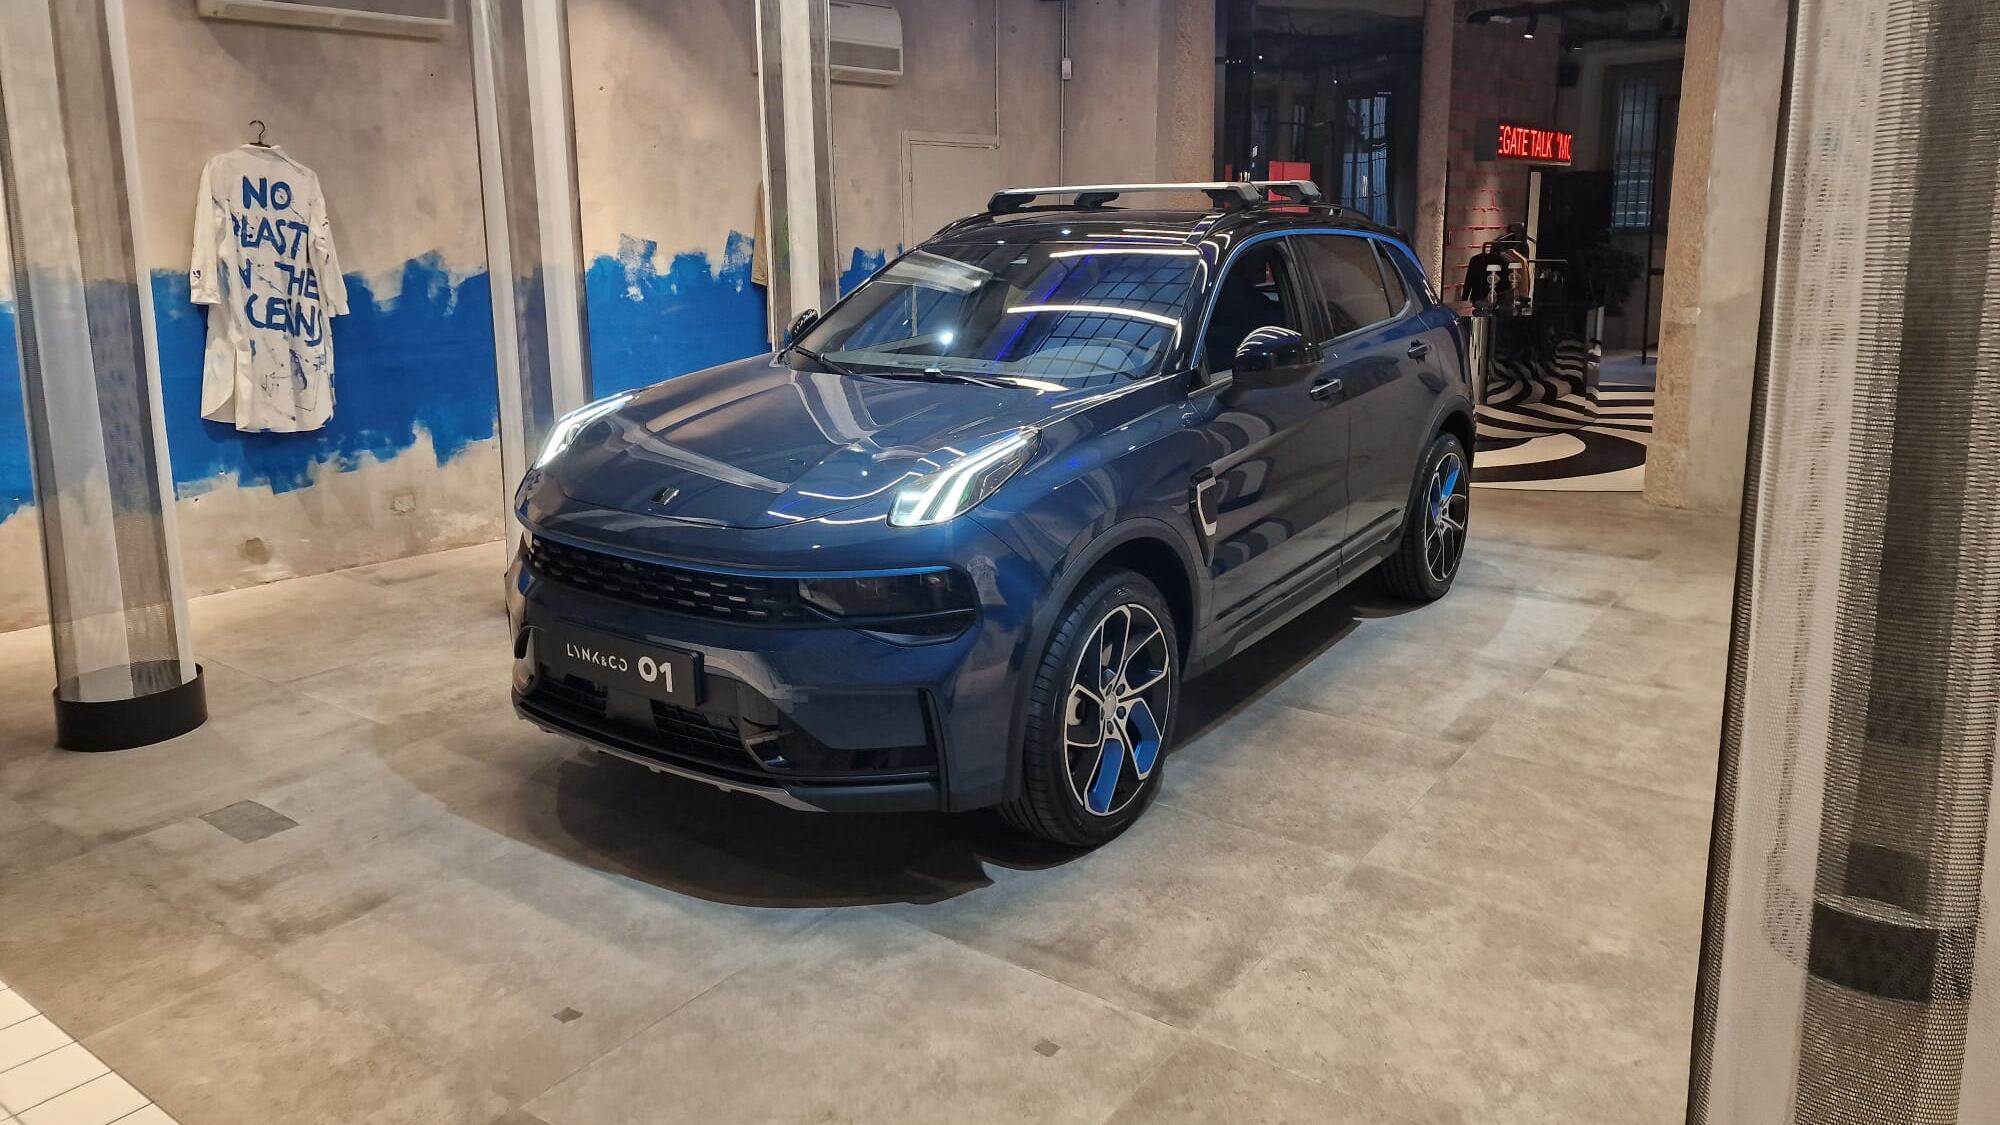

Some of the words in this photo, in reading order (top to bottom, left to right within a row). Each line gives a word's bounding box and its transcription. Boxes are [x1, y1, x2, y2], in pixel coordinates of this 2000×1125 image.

[1530, 130, 1554, 157] TALK
[242, 176, 291, 210] NO
[274, 261, 320, 301] THE
[637, 656, 673, 693] 01
